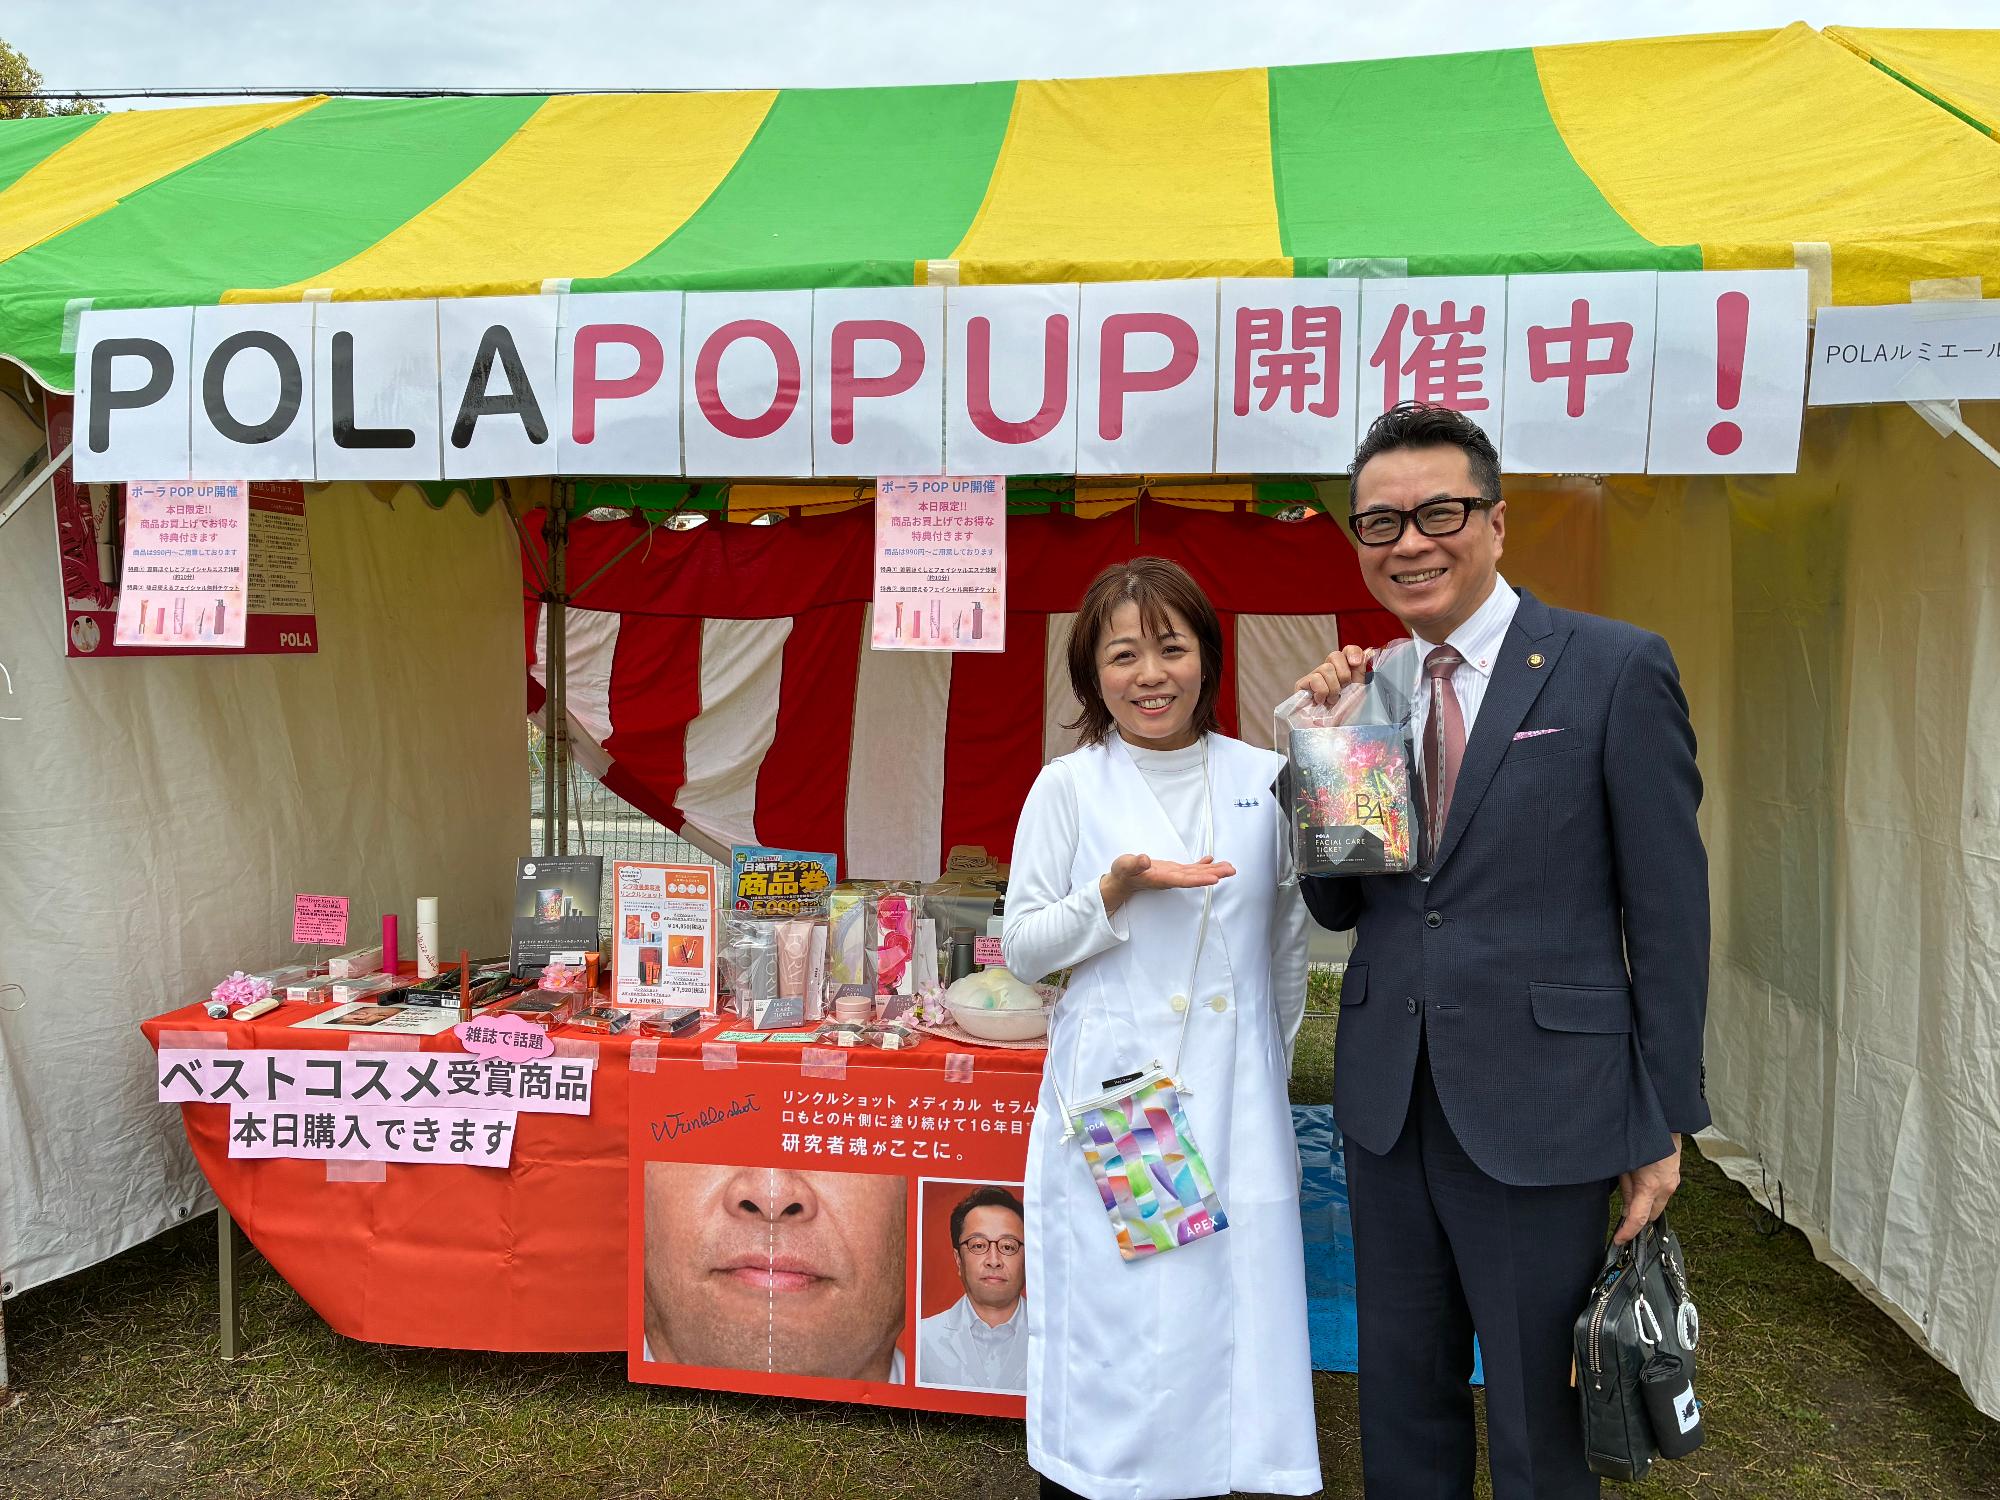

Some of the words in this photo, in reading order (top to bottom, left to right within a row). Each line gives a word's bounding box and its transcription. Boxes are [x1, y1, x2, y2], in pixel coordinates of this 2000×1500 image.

[132, 486, 166, 497] ポーラ
[170, 486, 194, 497] POP
[881, 481, 919, 493] ポーラ
[922, 482, 949, 493] POP
[140, 519, 238, 529] 商品お買上げでお得な
[891, 516, 995, 527] 商品お買上げでお得な
[159, 533, 218, 542] 特典付きます
[911, 531, 974, 541] 特典付きます
[280, 632, 312, 647] POLA
[744, 861, 821, 872] 日進市デジタル
[738, 869, 830, 897] 商品券
[465, 1025, 545, 1051] 雑誌で話題
[159, 1055, 589, 1103] ベストコスメ受賞商品
[782, 1089, 897, 1107] リンクルショット
[907, 1095, 983, 1112] メディカル
[991, 1099, 1036, 1114] セラム
[232, 1111, 512, 1155] 本日購入できます
[1084, 1120, 1105, 1135] POLA
[781, 1133, 966, 1161] 研究者魂がここに。
[1185, 1215, 1218, 1238] APEX
